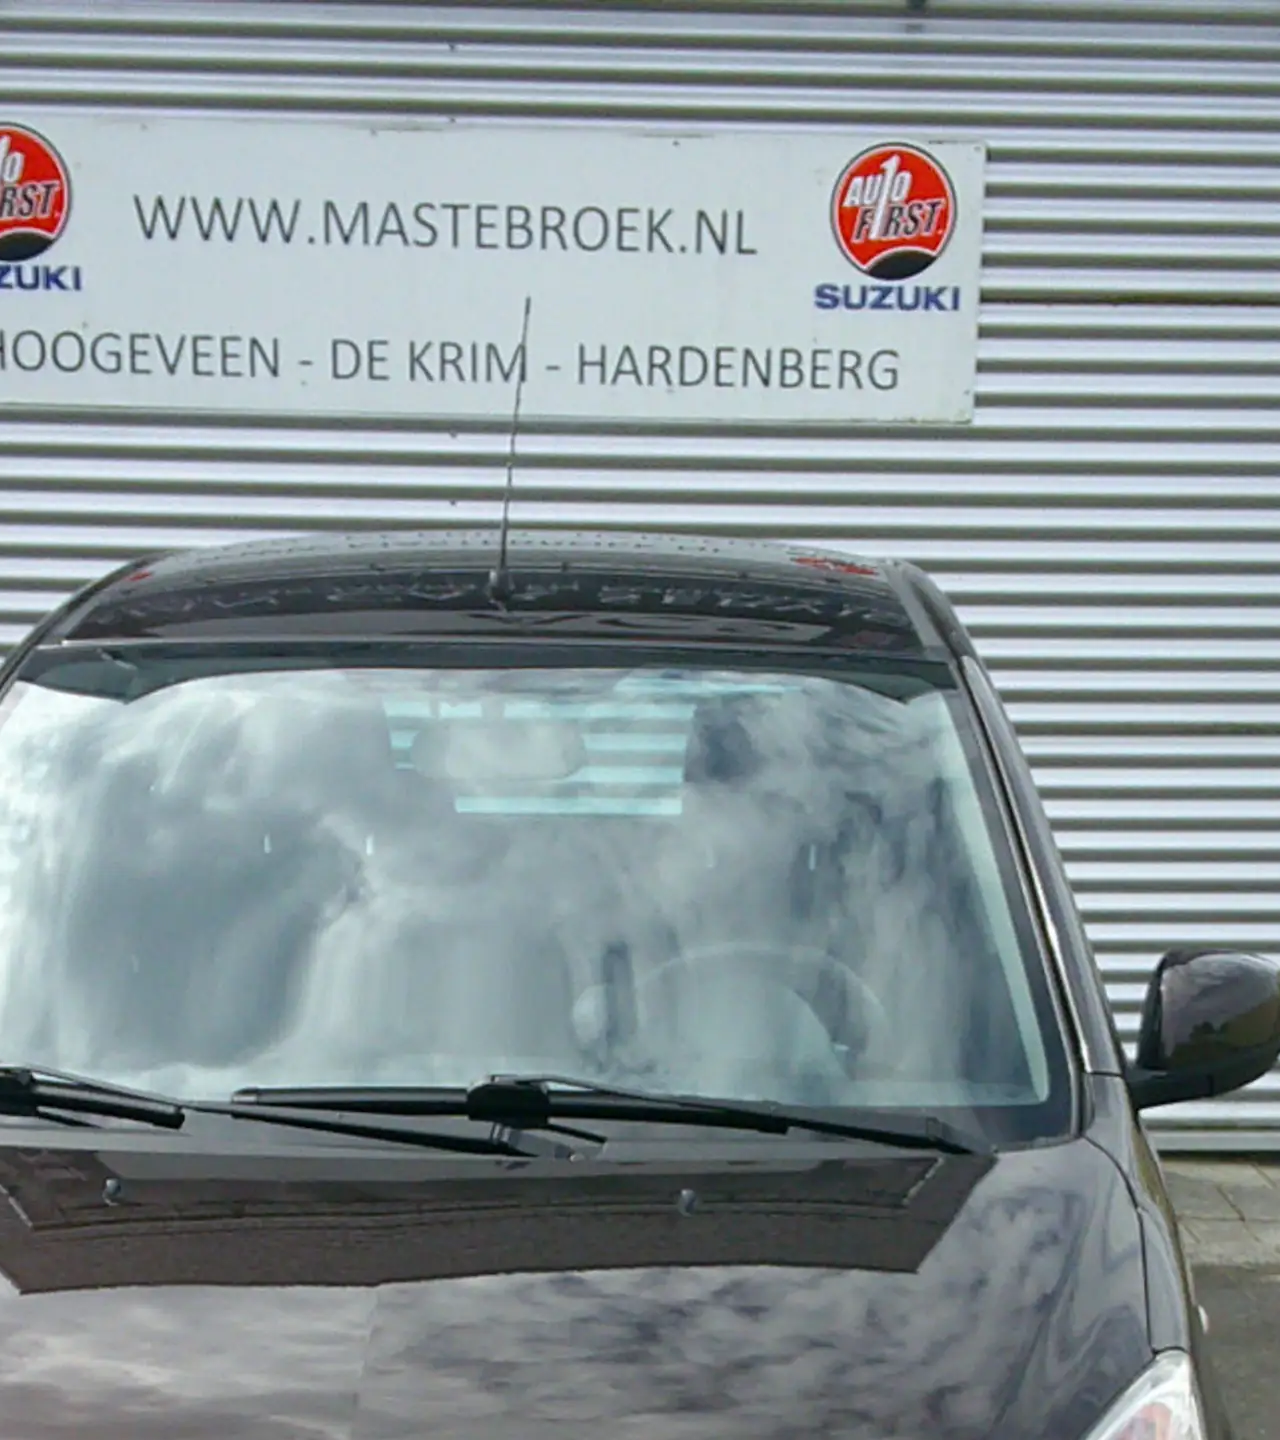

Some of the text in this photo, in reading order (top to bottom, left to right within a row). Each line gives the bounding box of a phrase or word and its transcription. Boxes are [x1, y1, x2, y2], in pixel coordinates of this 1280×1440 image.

[133, 194, 758, 255] WWW.MASTEBROEK.NL
[814, 283, 961, 312] SUZUKI
[331, 338, 390, 382] DE
[409, 340, 528, 383] KRIM
[578, 343, 899, 390] HARDENBERG
